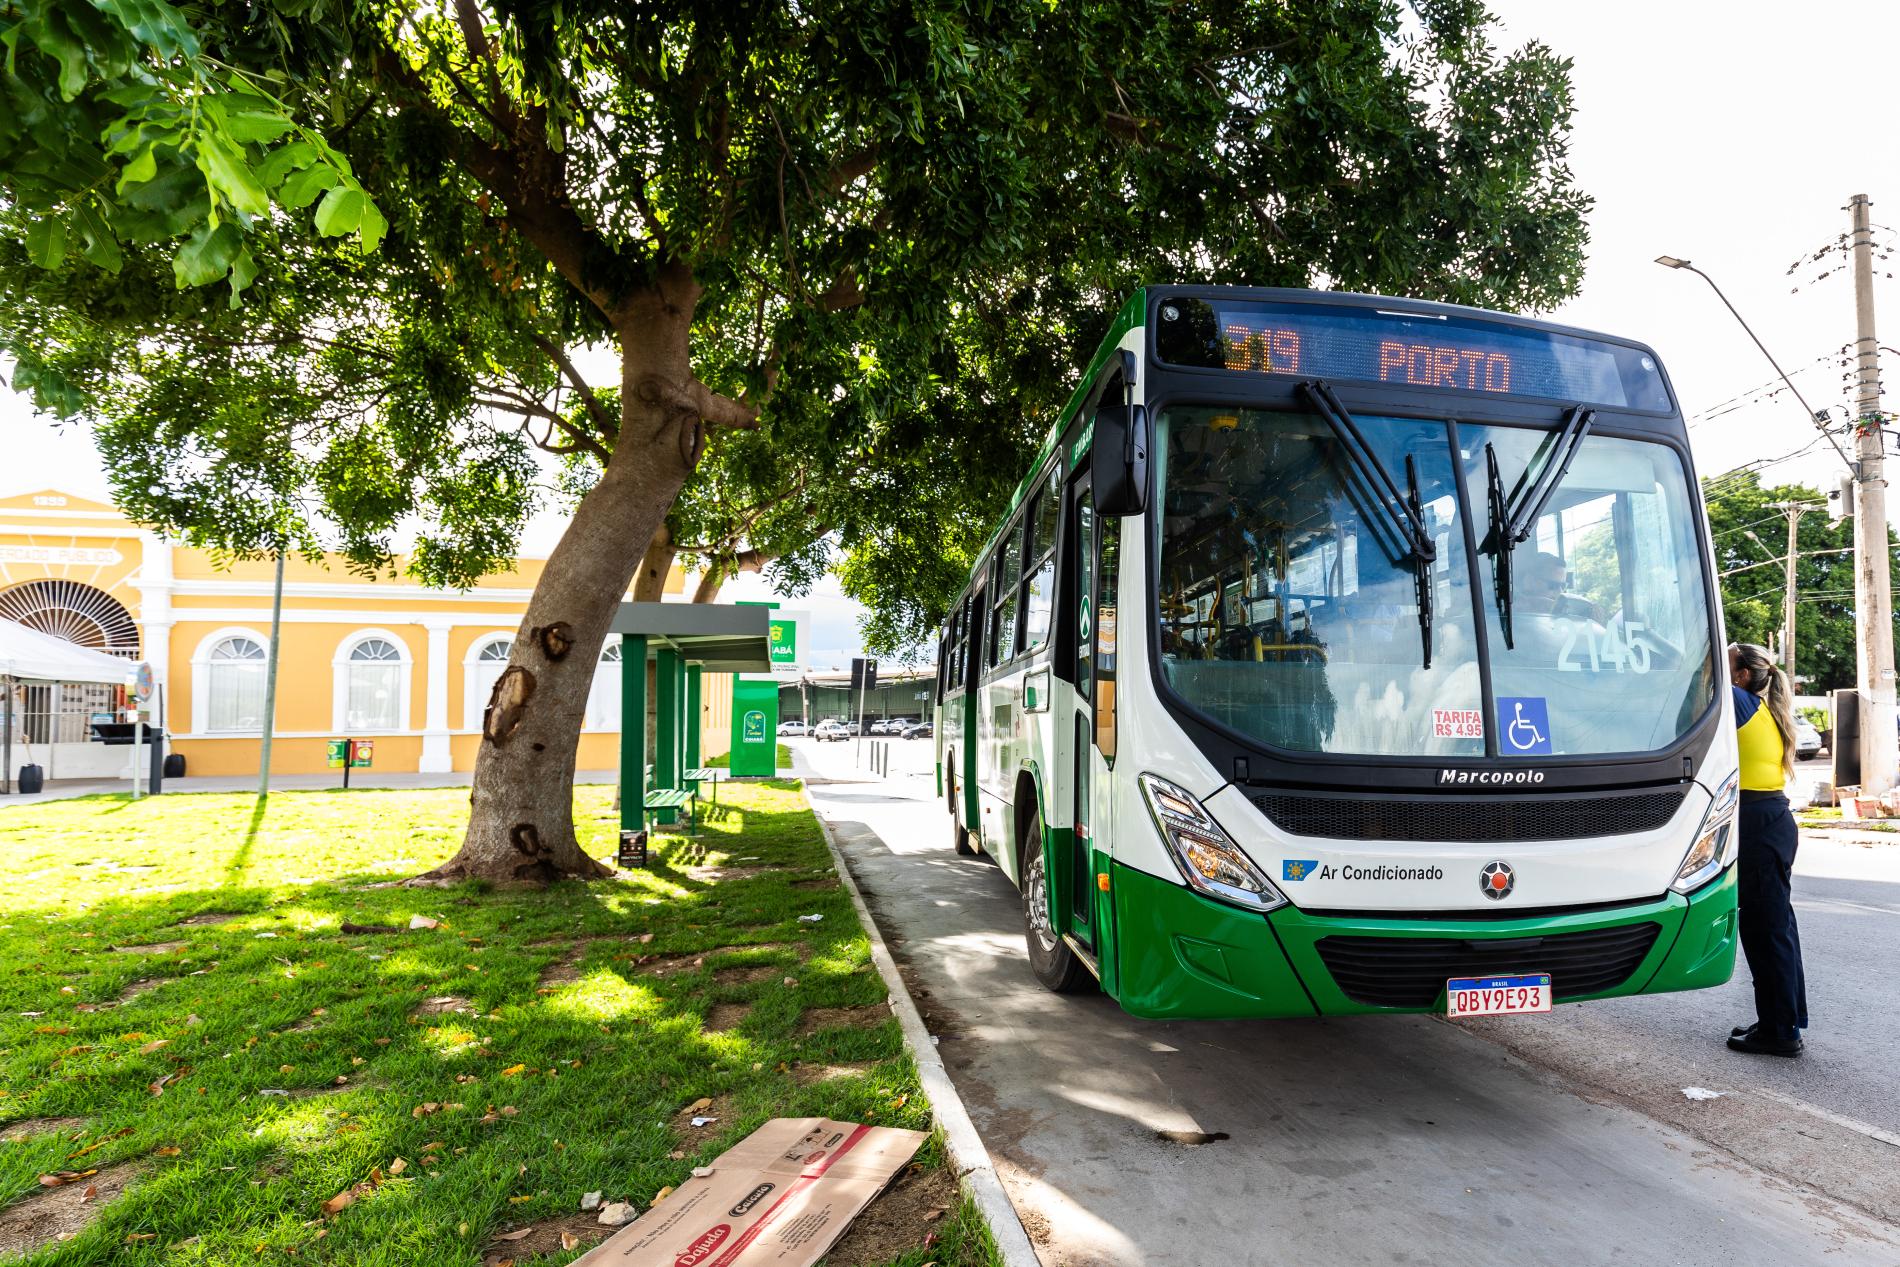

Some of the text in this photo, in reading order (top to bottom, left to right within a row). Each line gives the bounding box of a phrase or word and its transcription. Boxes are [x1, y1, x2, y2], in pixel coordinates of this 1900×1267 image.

[1225, 325, 1510, 393] 319 PORTO
[0, 548, 49, 561] ERCADO
[1552, 618, 1651, 674] 2145
[1434, 710, 1482, 724] TARIFA
[1436, 723, 1483, 737] R$ 4.95
[1440, 769, 1545, 785] Marcopolo
[1319, 864, 1444, 881] Ar Condicionado
[1457, 987, 1540, 1012] QBY9E93
[680, 1228, 726, 1266] Dajuda
